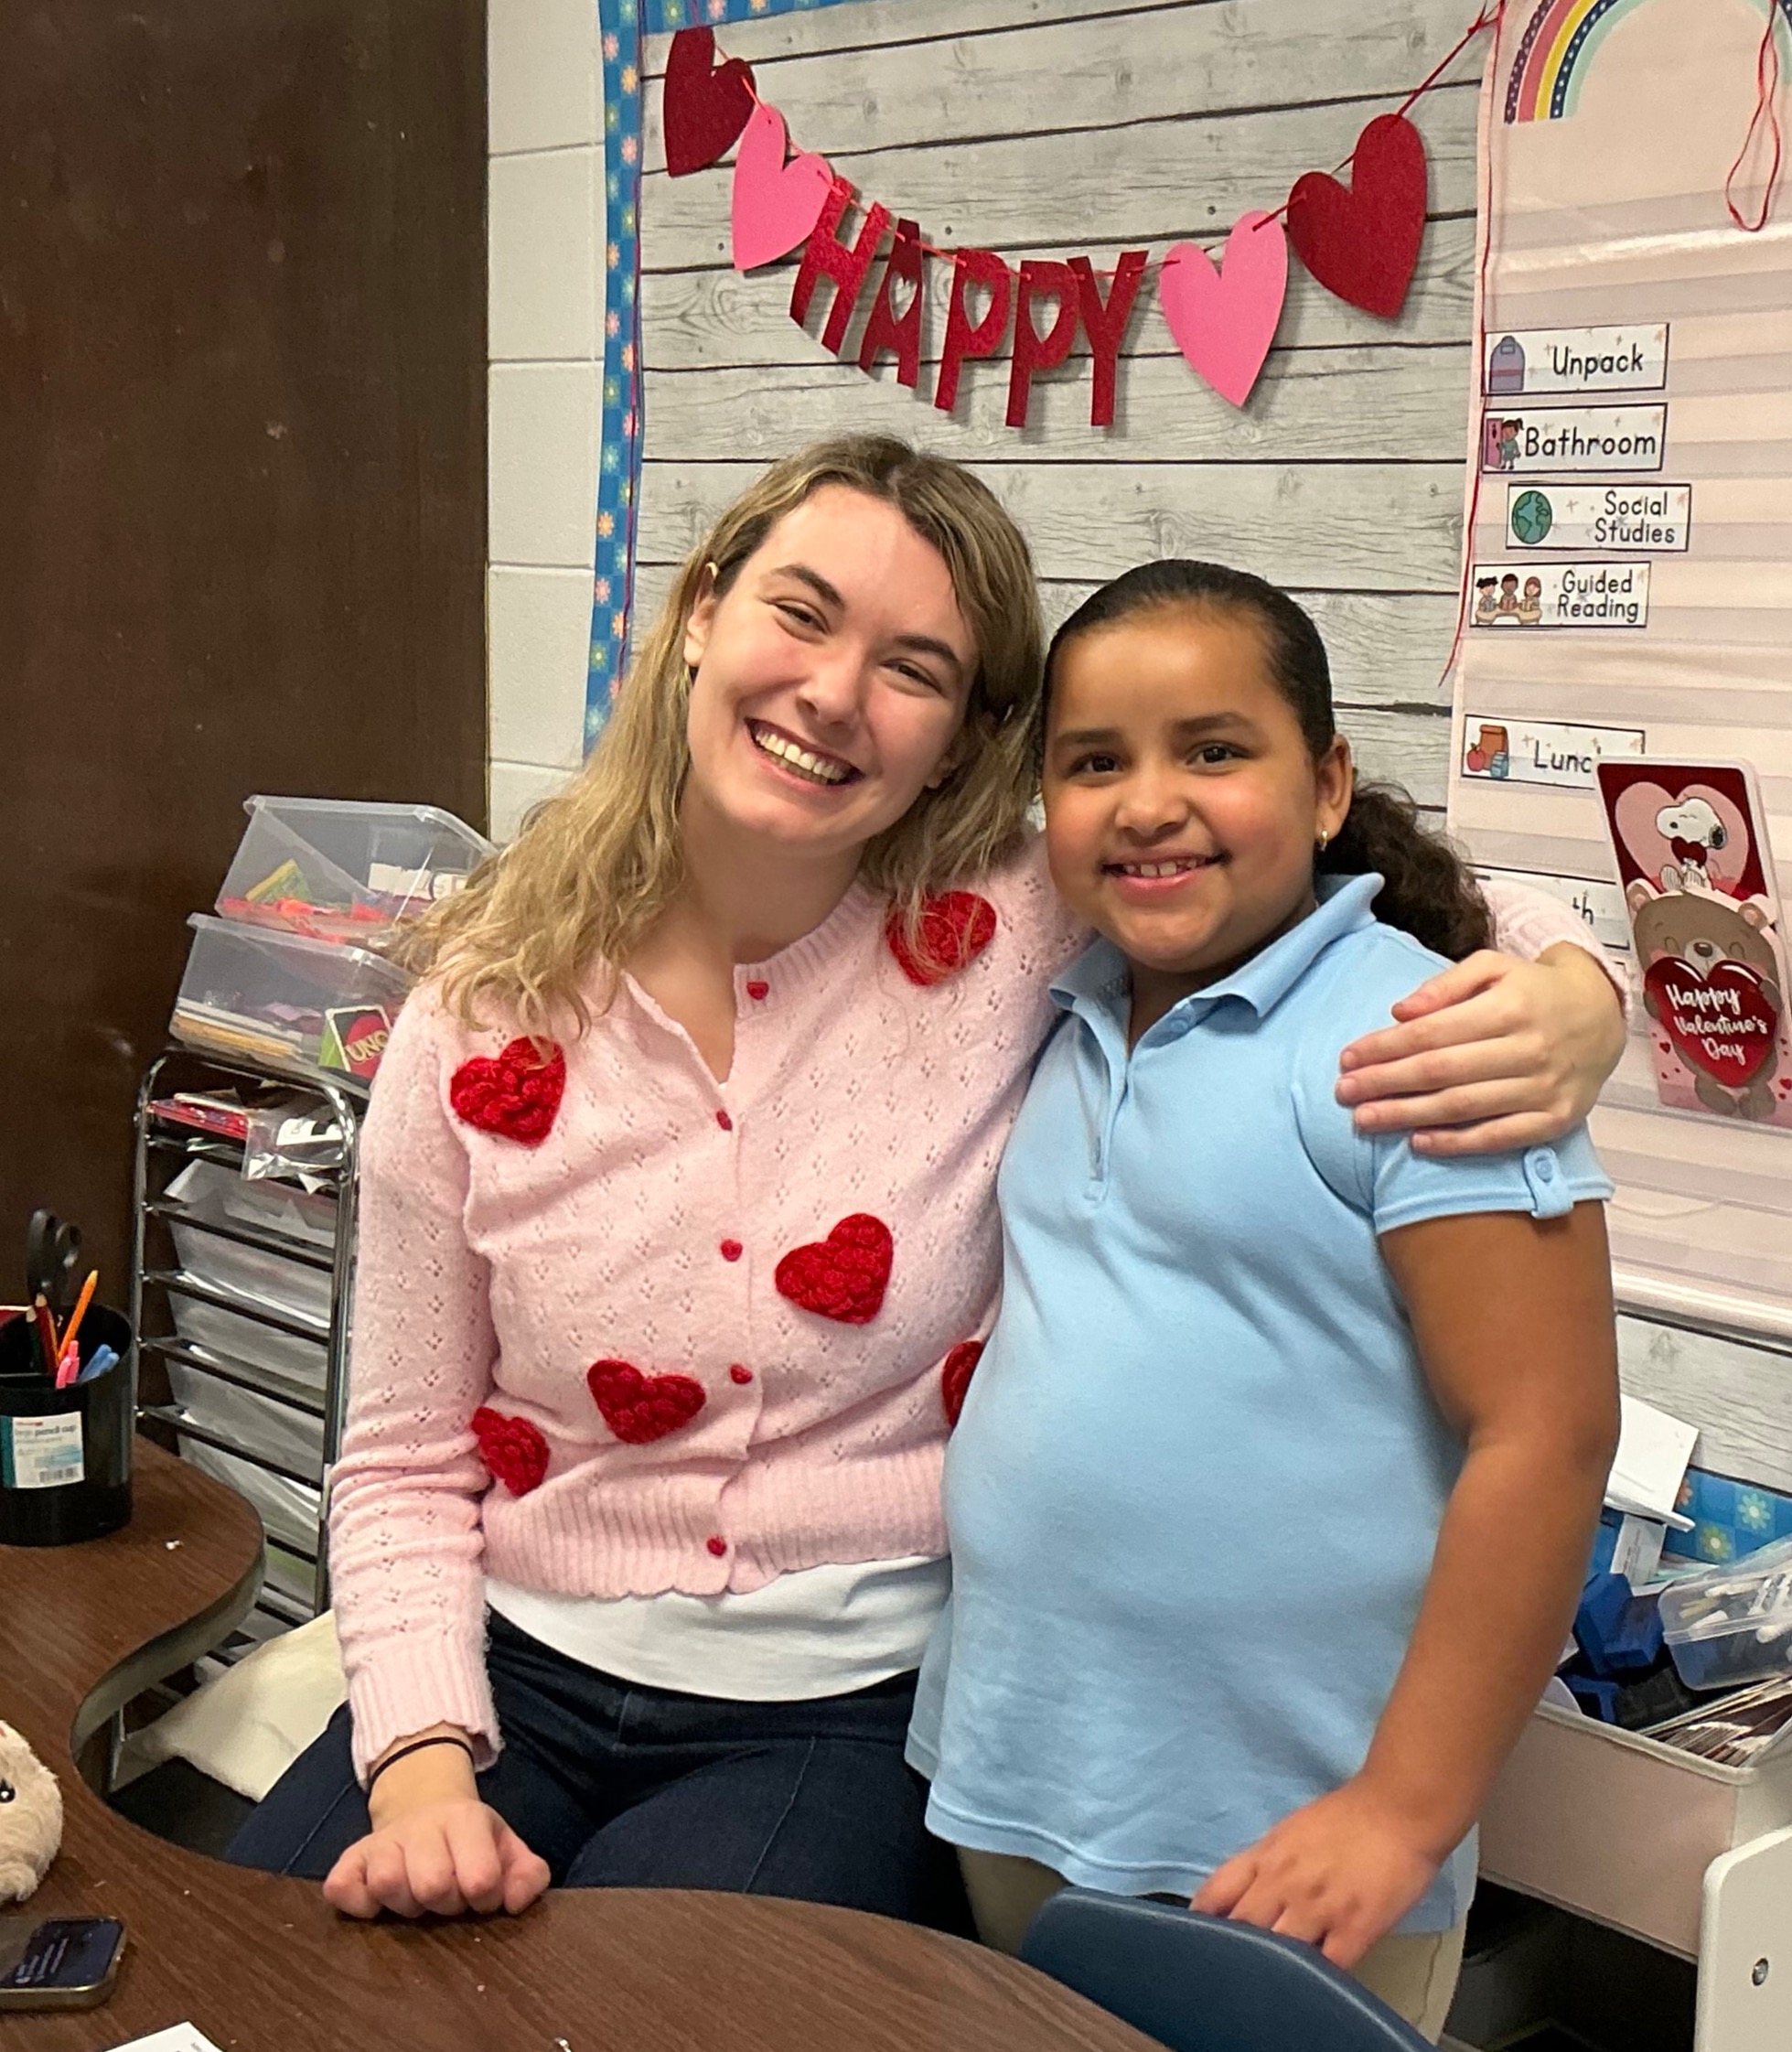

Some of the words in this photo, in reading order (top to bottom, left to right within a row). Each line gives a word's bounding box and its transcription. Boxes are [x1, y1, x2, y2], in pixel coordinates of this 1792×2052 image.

[789, 175, 1149, 427] HAPPY
[1552, 343, 1645, 381] Unpack
[1524, 426, 1657, 457] Bathroom
[1604, 489, 1669, 517] Social
[1593, 517, 1676, 544] Studies
[1561, 569, 1633, 595] Guided
[1557, 593, 1639, 623] Reading
[1533, 738, 1602, 774] Lunc
[1665, 983, 1742, 1015] Happy
[1673, 1013, 1768, 1037] Valentine's
[343, 1029, 390, 1063] UNO
[1701, 1037, 1745, 1067] Day
